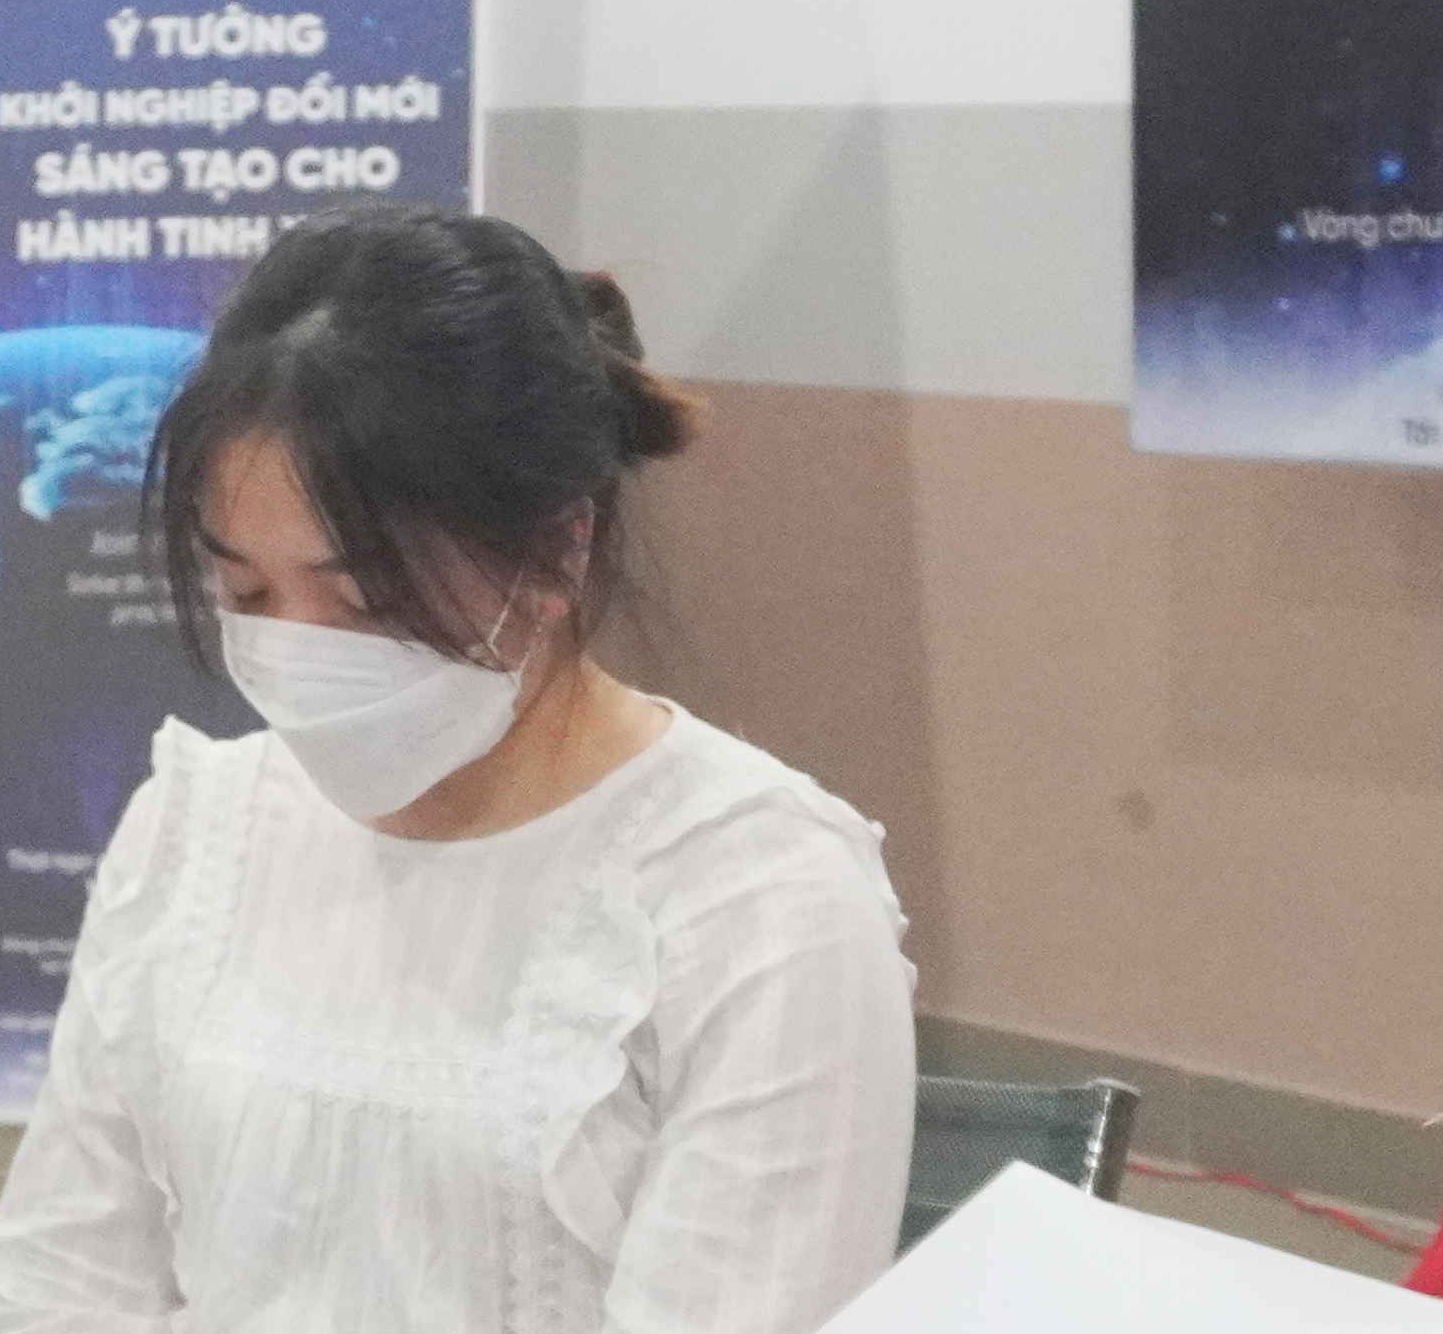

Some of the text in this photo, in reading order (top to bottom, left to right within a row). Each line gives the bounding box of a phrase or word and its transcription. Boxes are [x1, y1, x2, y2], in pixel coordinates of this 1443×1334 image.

[108, 3, 328, 59] Ý TƯỞNG
[106, 79, 259, 133] NGHIỆP
[356, 75, 440, 122] MỚI
[35, 142, 400, 202] SÁNG TẠO CHO
[17, 208, 270, 261] HÀNH TINH
